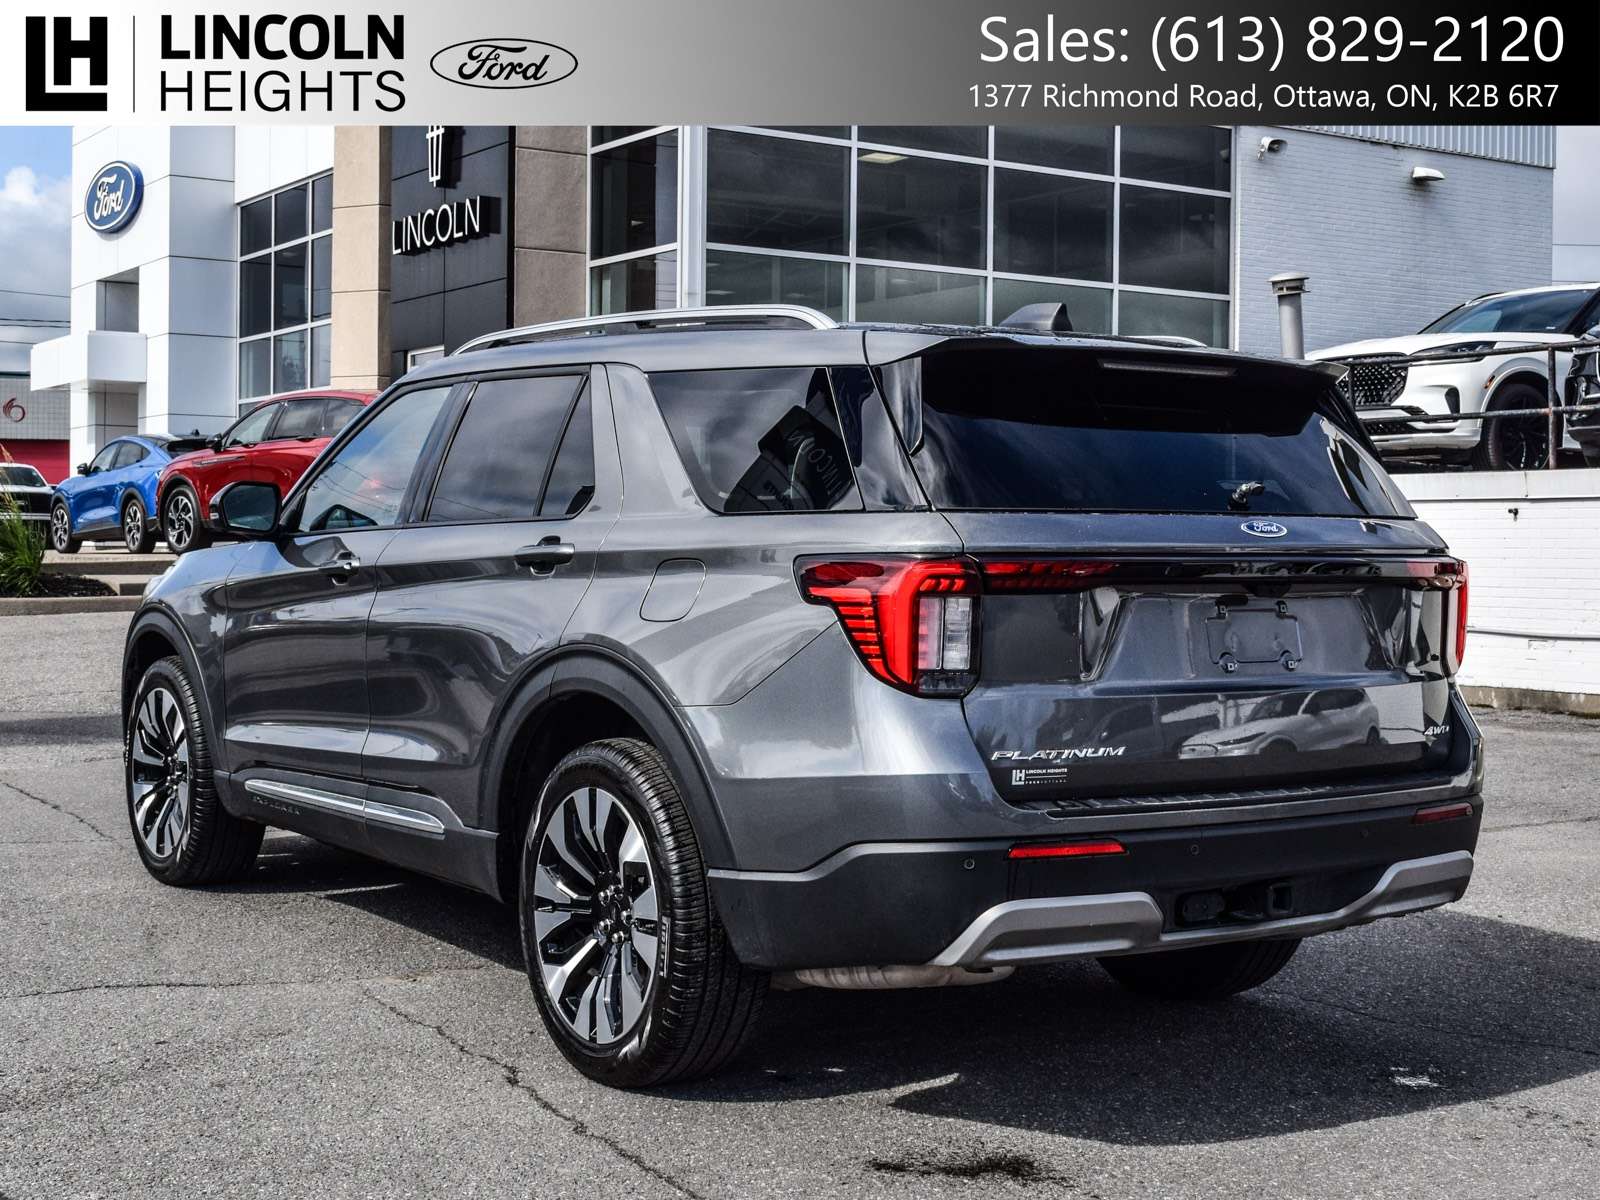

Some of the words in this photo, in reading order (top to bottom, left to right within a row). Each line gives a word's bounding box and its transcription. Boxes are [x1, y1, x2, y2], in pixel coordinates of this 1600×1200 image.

[93, 174, 124, 221] Ford
[392, 195, 480, 255] LINCOLN
[991, 746, 1126, 761] PLATINUM
